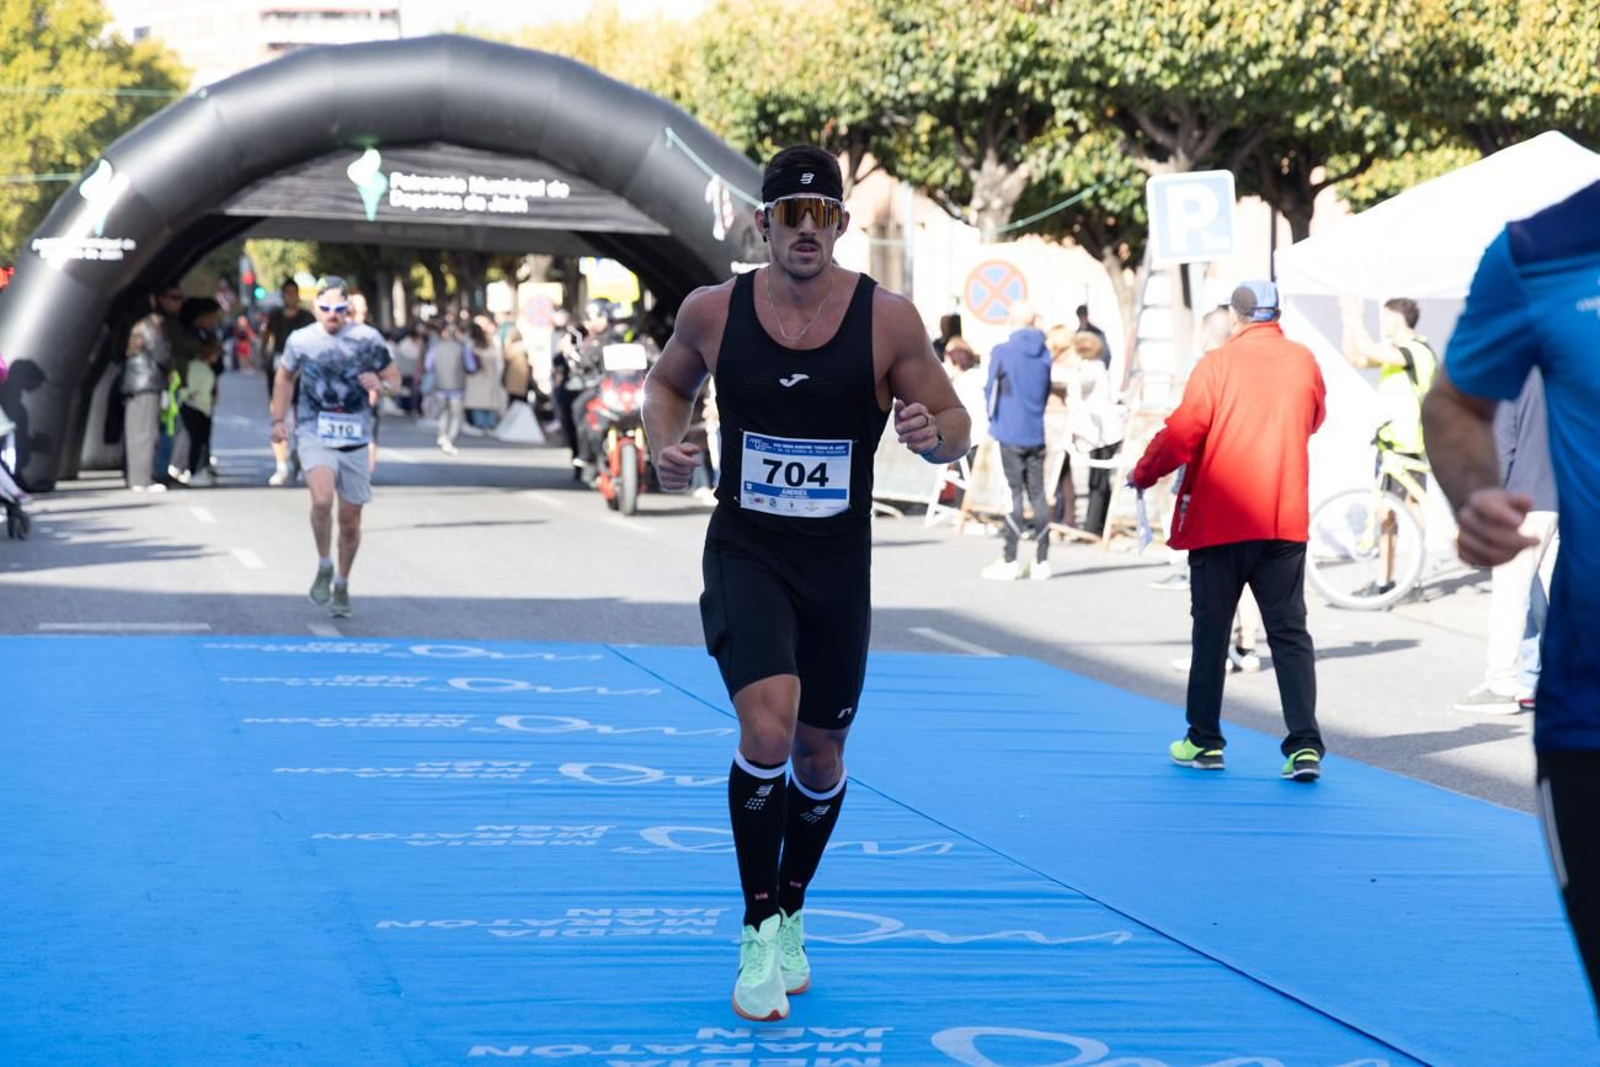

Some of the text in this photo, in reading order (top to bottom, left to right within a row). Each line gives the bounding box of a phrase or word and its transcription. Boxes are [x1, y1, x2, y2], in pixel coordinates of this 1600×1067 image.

[1165, 183, 1219, 255] P
[327, 424, 354, 434] 310
[762, 458, 829, 487] 704
[487, 928, 713, 937] MEDIA
[468, 1043, 882, 1058] MARATÓN
[606, 1058, 882, 1067] MEDIA
